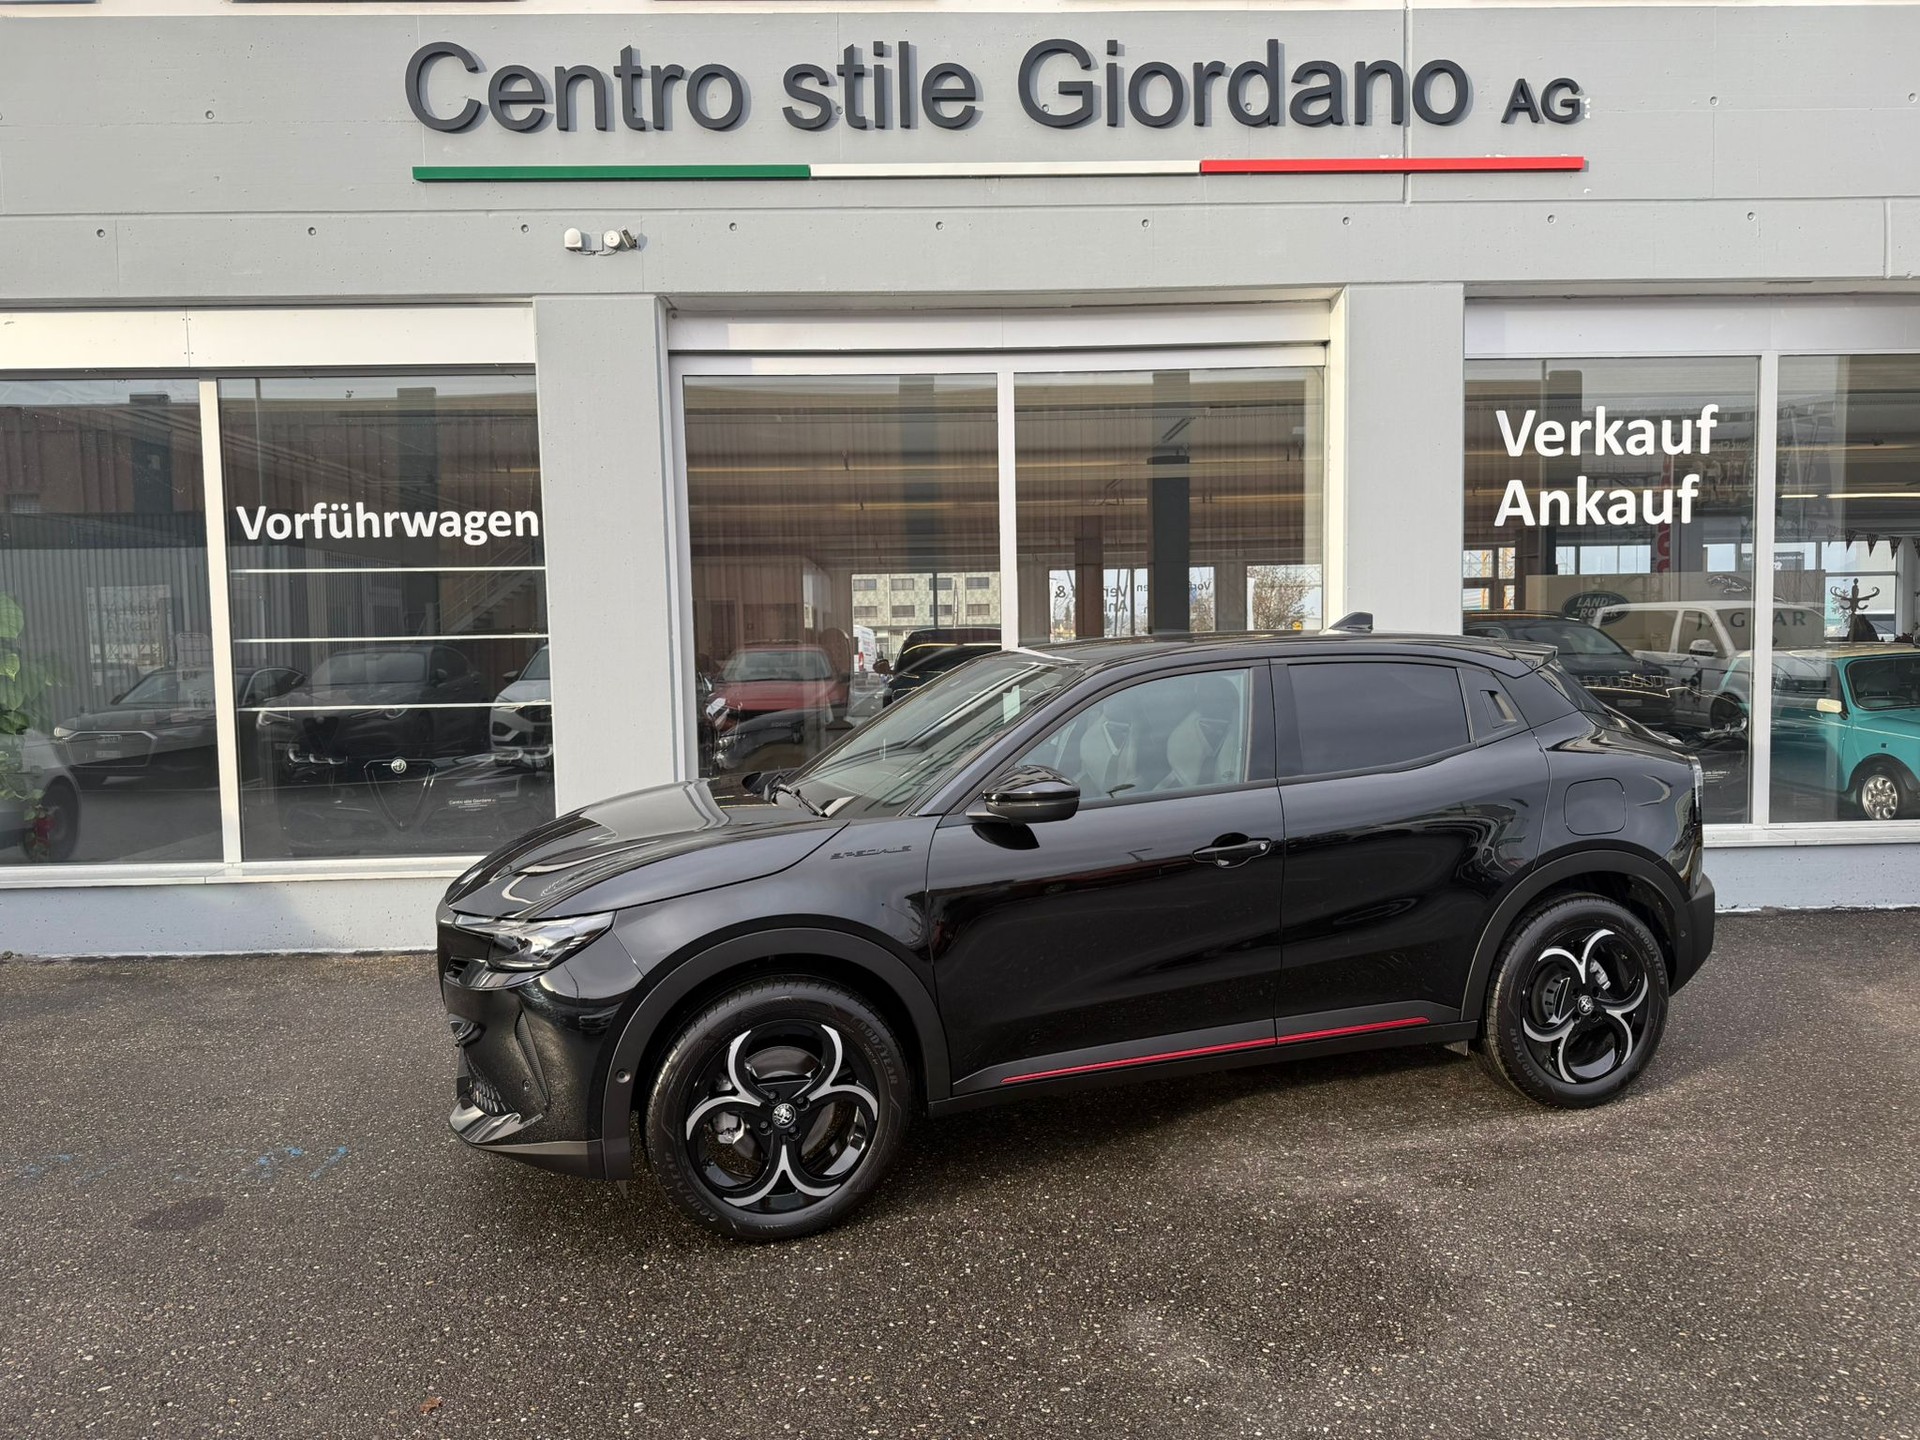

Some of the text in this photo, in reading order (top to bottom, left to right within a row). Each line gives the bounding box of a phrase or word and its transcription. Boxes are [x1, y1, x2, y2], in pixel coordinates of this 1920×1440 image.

[405, 38, 1583, 133] Centro stile Giordano AG
[1495, 403, 1719, 457] Verkauf
[1493, 473, 1700, 527] Ankauf
[236, 502, 539, 545] Vorführwagen
[1576, 597, 1609, 608] LAND
[1579, 606, 1618, 618] ROER
[1696, 611, 1807, 632] JGAR
